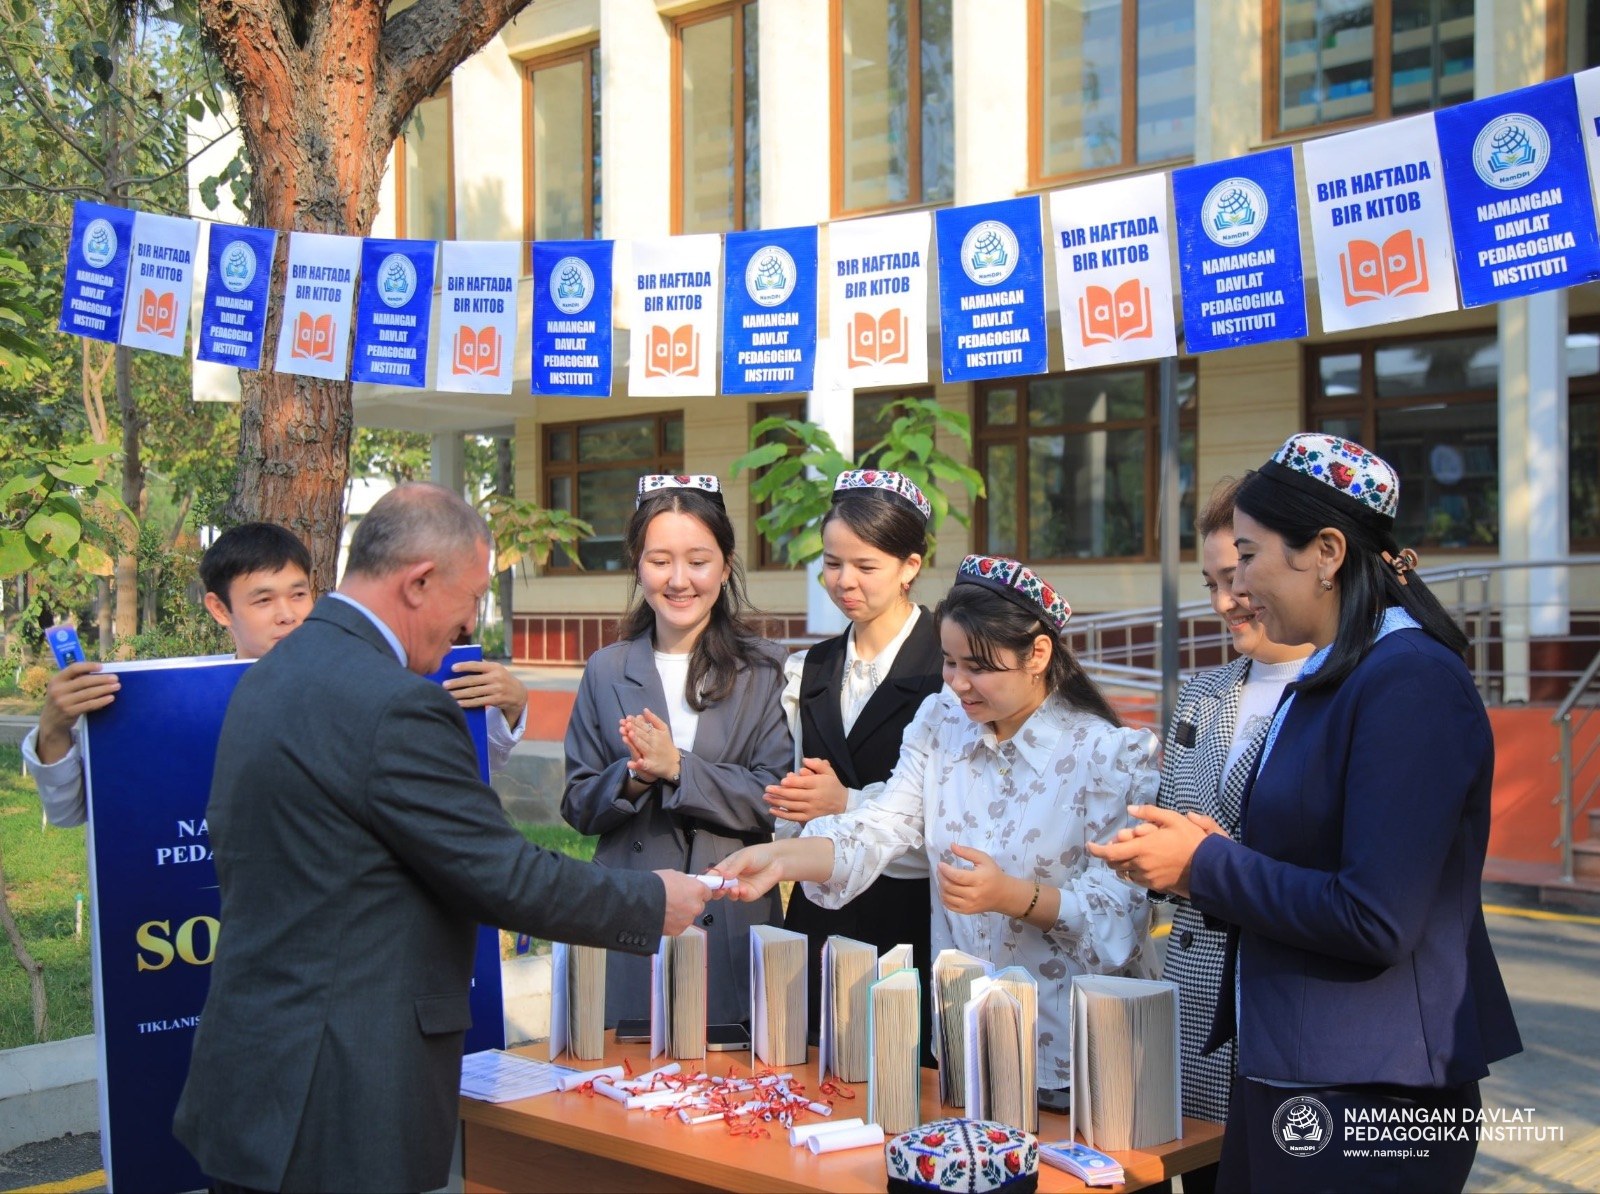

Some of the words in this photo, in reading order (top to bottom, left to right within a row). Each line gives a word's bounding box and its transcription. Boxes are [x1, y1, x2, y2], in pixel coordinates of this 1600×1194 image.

[1317, 178, 1347, 202] BIR
[1351, 161, 1431, 194] HAFTADA
[1500, 171, 1530, 183] NamDPI
[1331, 203, 1362, 226] BIR
[1366, 191, 1421, 219] KITOB
[1477, 188, 1562, 222] NAMANGAN
[1061, 229, 1086, 248] BIR
[1090, 216, 1159, 243] HAFTADA
[1495, 214, 1550, 241] DAVLAT
[138, 243, 150, 258] BIR
[153, 244, 190, 264] HAFTADA
[1478, 231, 1576, 267] PEDAGOGIKA
[837, 259, 859, 276] BIR
[862, 251, 920, 272] HAFTADA
[1073, 253, 1097, 272] BIR
[1102, 244, 1149, 267] KITOB
[1202, 249, 1276, 276] NAMANGAN
[76, 270, 114, 286] NAMANGAN
[140, 263, 154, 278] BIR
[155, 265, 182, 282] KITOB
[292, 264, 306, 279] BIR
[309, 266, 350, 283] HAFTADA
[1492, 256, 1567, 287] INSTITUTI
[448, 276, 465, 291] BIR
[467, 277, 512, 292] HAFTADA
[638, 274, 657, 290] BIR
[660, 271, 711, 288] HAFTADA
[845, 282, 867, 299] BIR
[870, 276, 910, 296] KITOB
[1216, 272, 1263, 294] DAVLAT
[80, 285, 105, 301] DAVLAT
[296, 285, 311, 300] BIR
[312, 286, 341, 302] KITOB
[961, 290, 1024, 310] NAMANGAN
[71, 298, 112, 317] PEDAGOGIKA
[216, 296, 252, 312] NAMANGAN
[454, 298, 470, 312] BIR
[473, 299, 504, 313] KITOB
[645, 296, 664, 312] BIR
[667, 295, 702, 310] KITOB
[1201, 290, 1284, 317] PEDAGOGIKA
[74, 314, 105, 331] INSTITUTI
[221, 312, 244, 326] DAVLAT
[373, 313, 416, 326] NAMANGAN
[547, 321, 595, 333] NAMANGAN
[743, 312, 798, 328] NAMANGAN
[973, 310, 1014, 328] DAVLAT
[1212, 312, 1276, 336] INSTITUTI
[210, 326, 252, 342] PEDAGOGIKA
[379, 330, 408, 343] DAVLAT
[752, 332, 788, 346] DAVLAT
[958, 328, 1030, 349] PEDAGOGIKA
[213, 342, 246, 356] INSTITUTI
[367, 345, 417, 359] PEDAGOGIKA
[555, 338, 586, 350] DAVLAT
[544, 355, 599, 368] PEDAGOGIKA
[738, 349, 802, 364] PEDAGOGIKA
[967, 349, 1022, 367] INSTITUTI
[371, 363, 410, 376] INSTITUTI
[745, 367, 794, 382] INSTITUTI
[550, 372, 592, 385] INSTITUTI
[136, 916, 221, 971] SO
